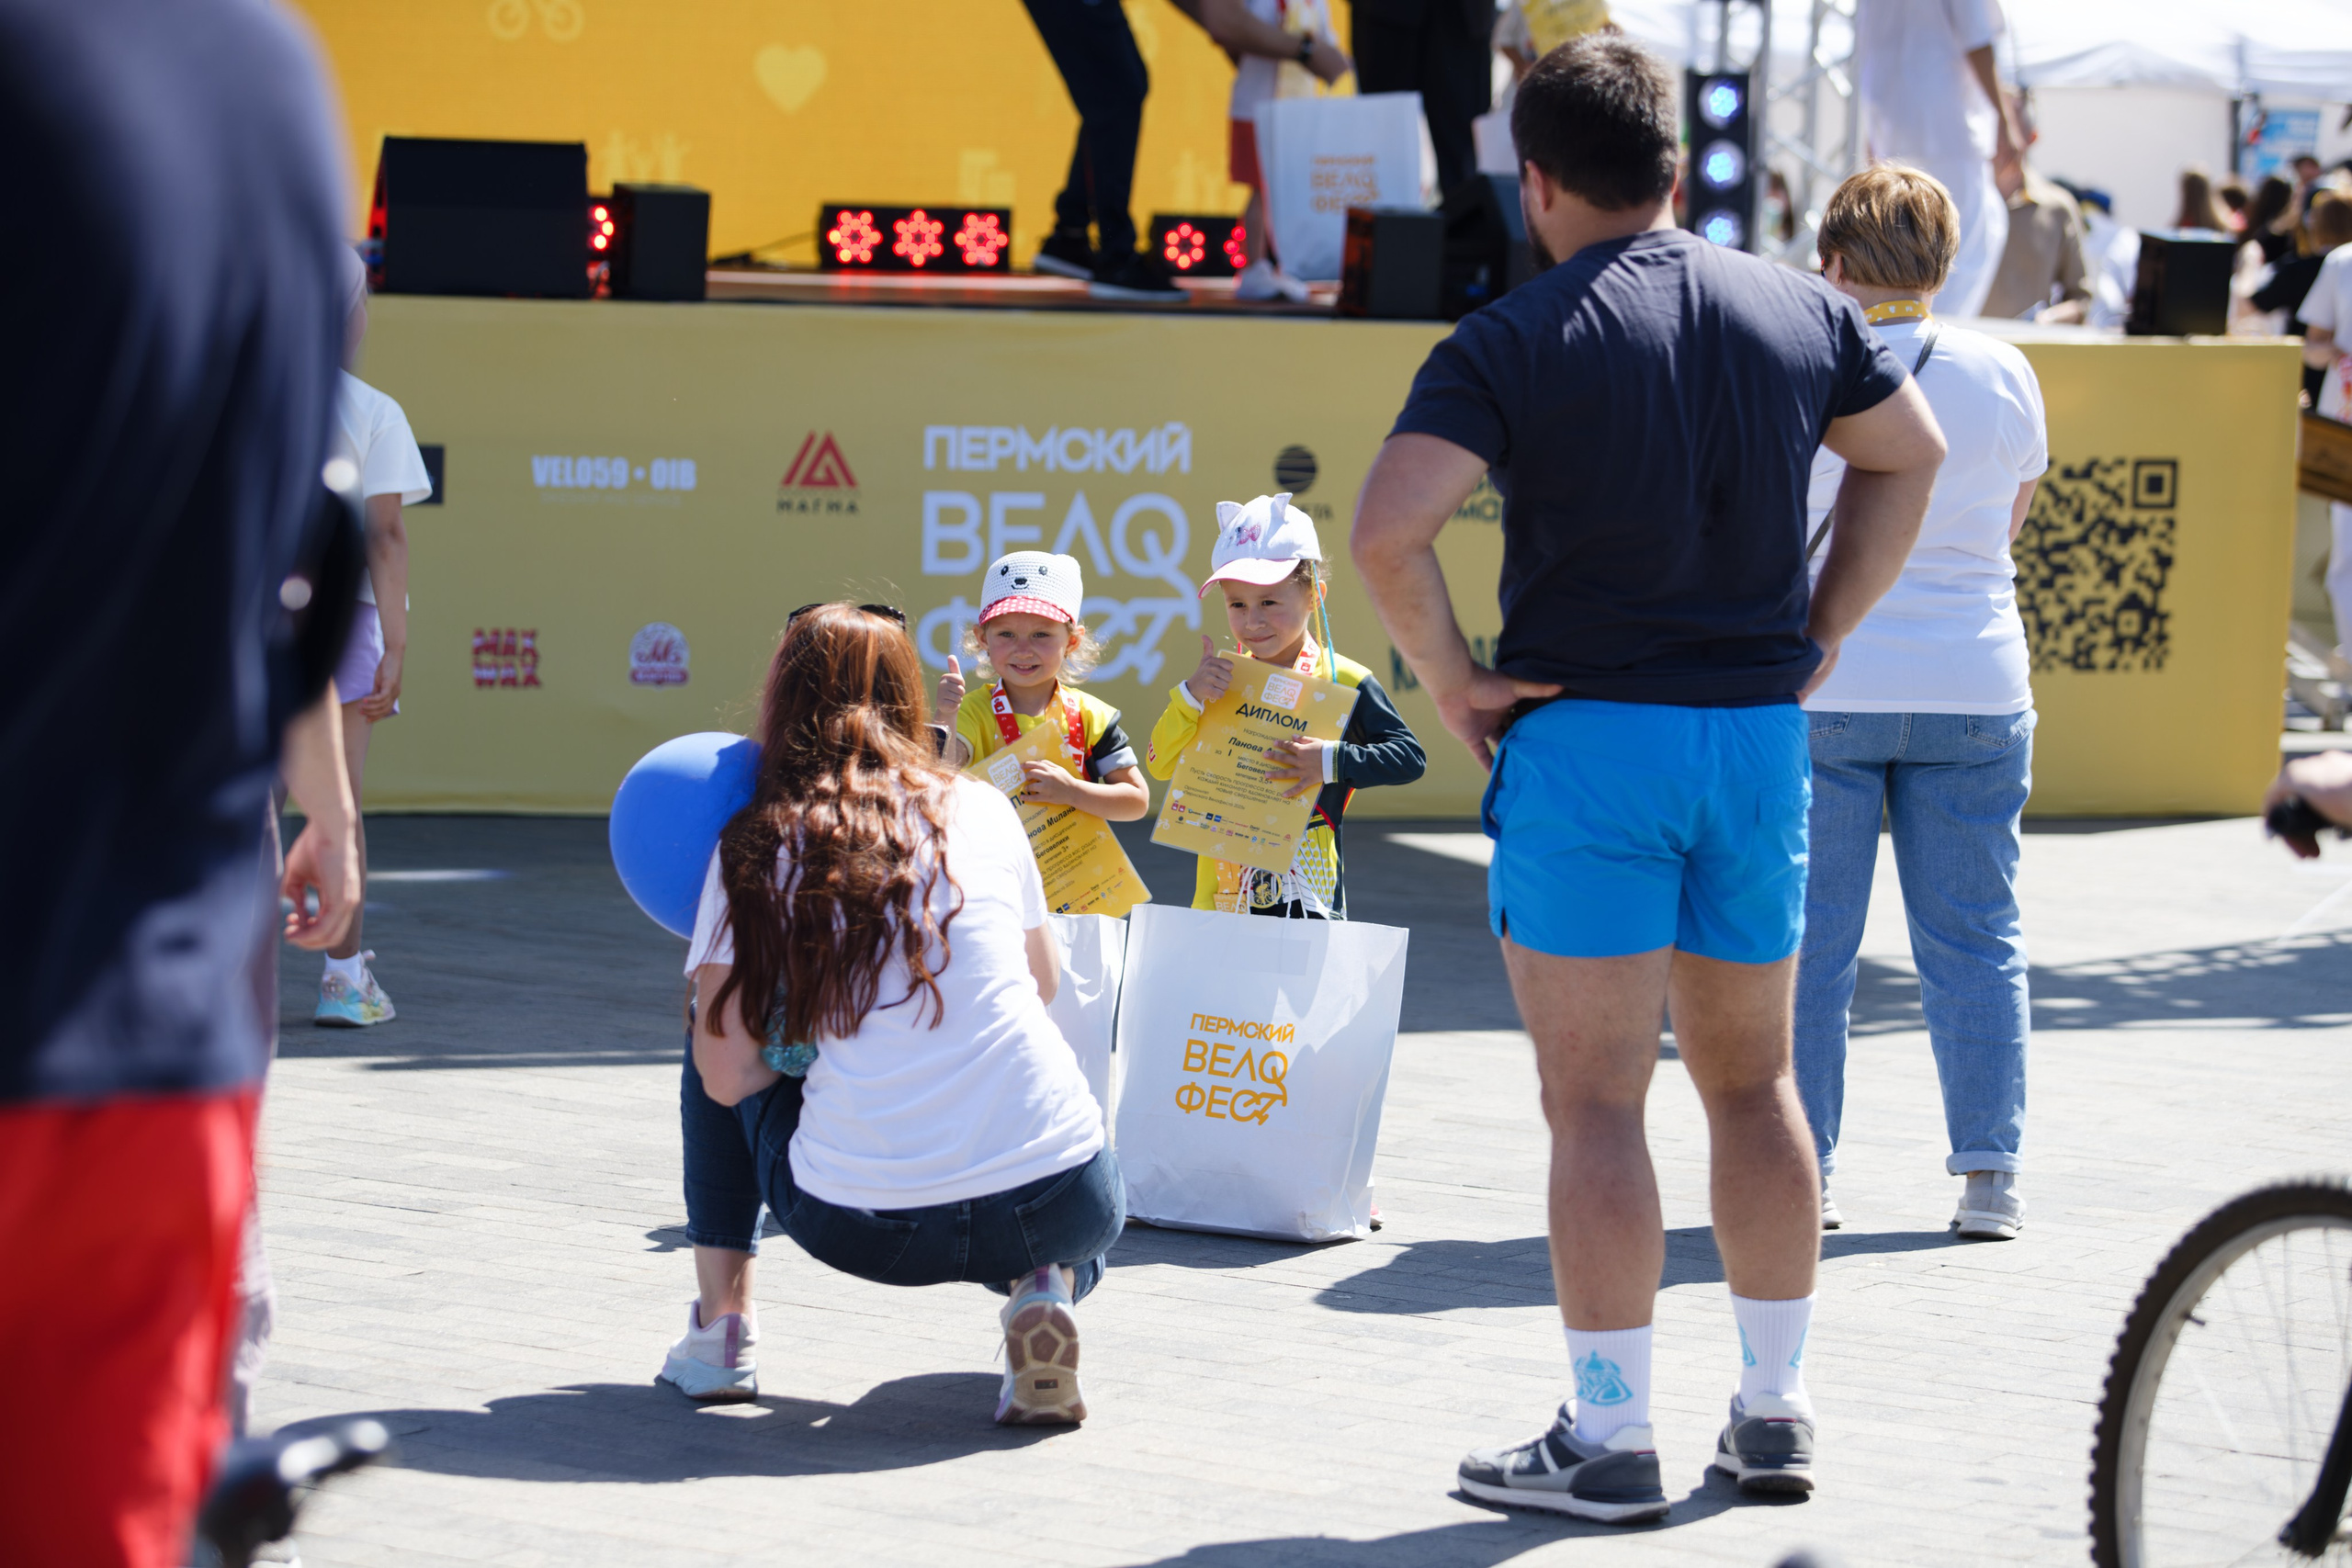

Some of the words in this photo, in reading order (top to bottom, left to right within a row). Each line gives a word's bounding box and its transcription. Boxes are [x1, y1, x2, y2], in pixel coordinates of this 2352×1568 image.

[923, 422, 1193, 475] ПЕРМСКИЙ
[776, 499, 861, 515] МАГМА
[922, 489, 1192, 579] ВЕЛО
[1267, 682, 1296, 698] ВЕЛО
[1236, 703, 1307, 732] ДИПЛОМ
[1228, 737, 1263, 752] Панова
[992, 763, 1019, 784] ВЕЛО
[1237, 761, 1266, 775] Беговел
[1233, 779, 1265, 793] прогресса
[1046, 806, 1077, 828] Милана
[1035, 835, 1070, 860] Беговелики
[1190, 1012, 1295, 1044] ПЕРМСКИЙ
[1182, 1038, 1288, 1085] ВЕЛО
[1175, 1081, 1288, 1126] ФЕСТ
